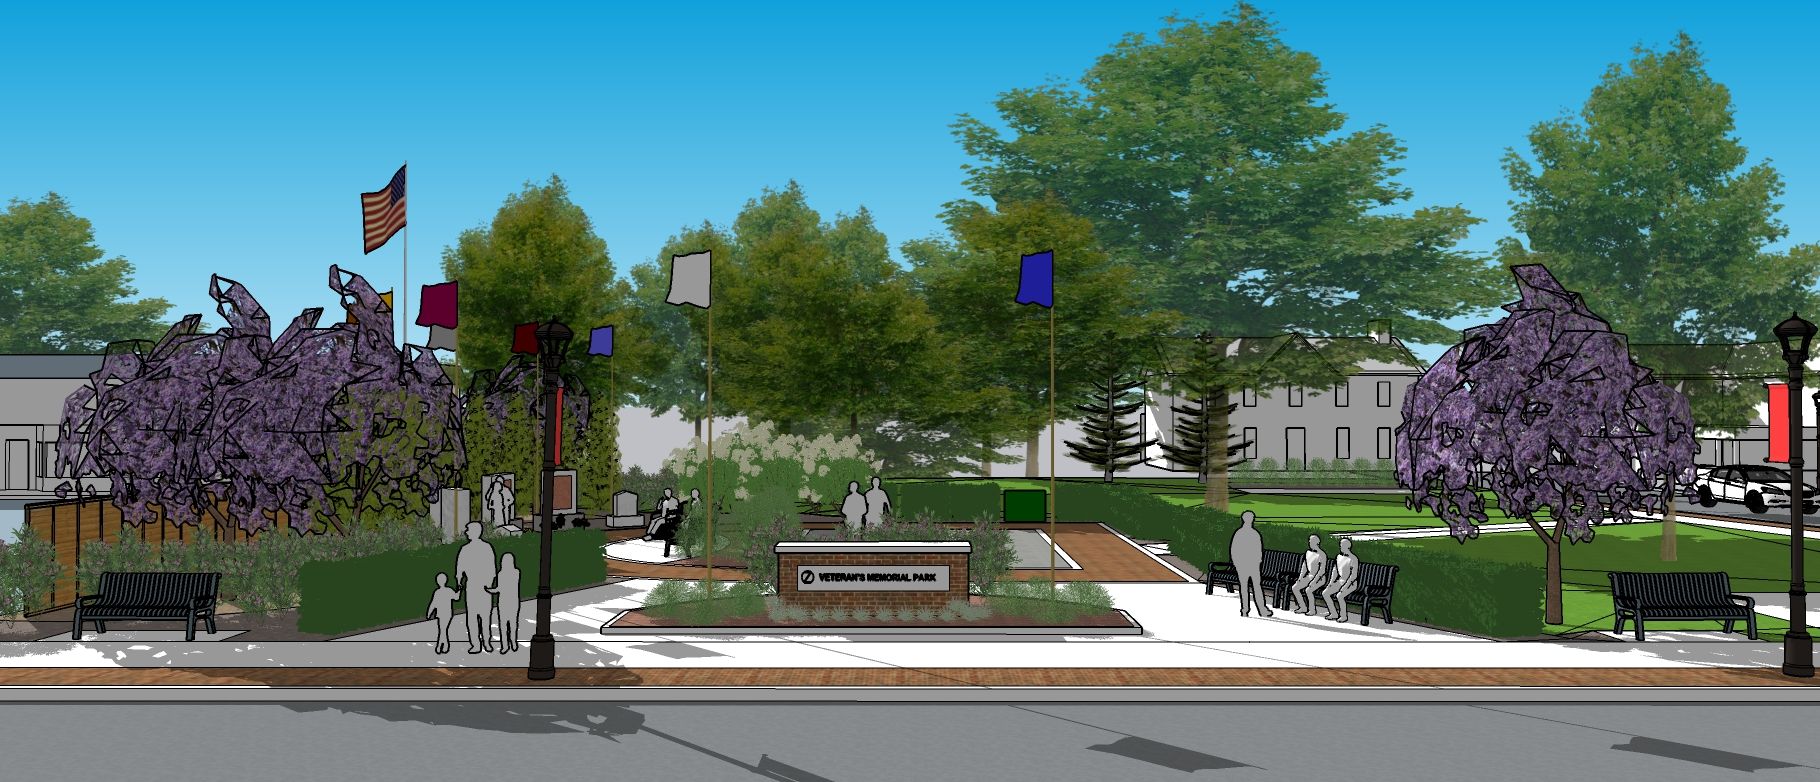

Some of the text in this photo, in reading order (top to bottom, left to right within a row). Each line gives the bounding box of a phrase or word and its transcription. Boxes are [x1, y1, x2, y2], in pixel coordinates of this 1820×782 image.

[818, 573, 936, 582] VETERAN'S MEMORIAL PARK
